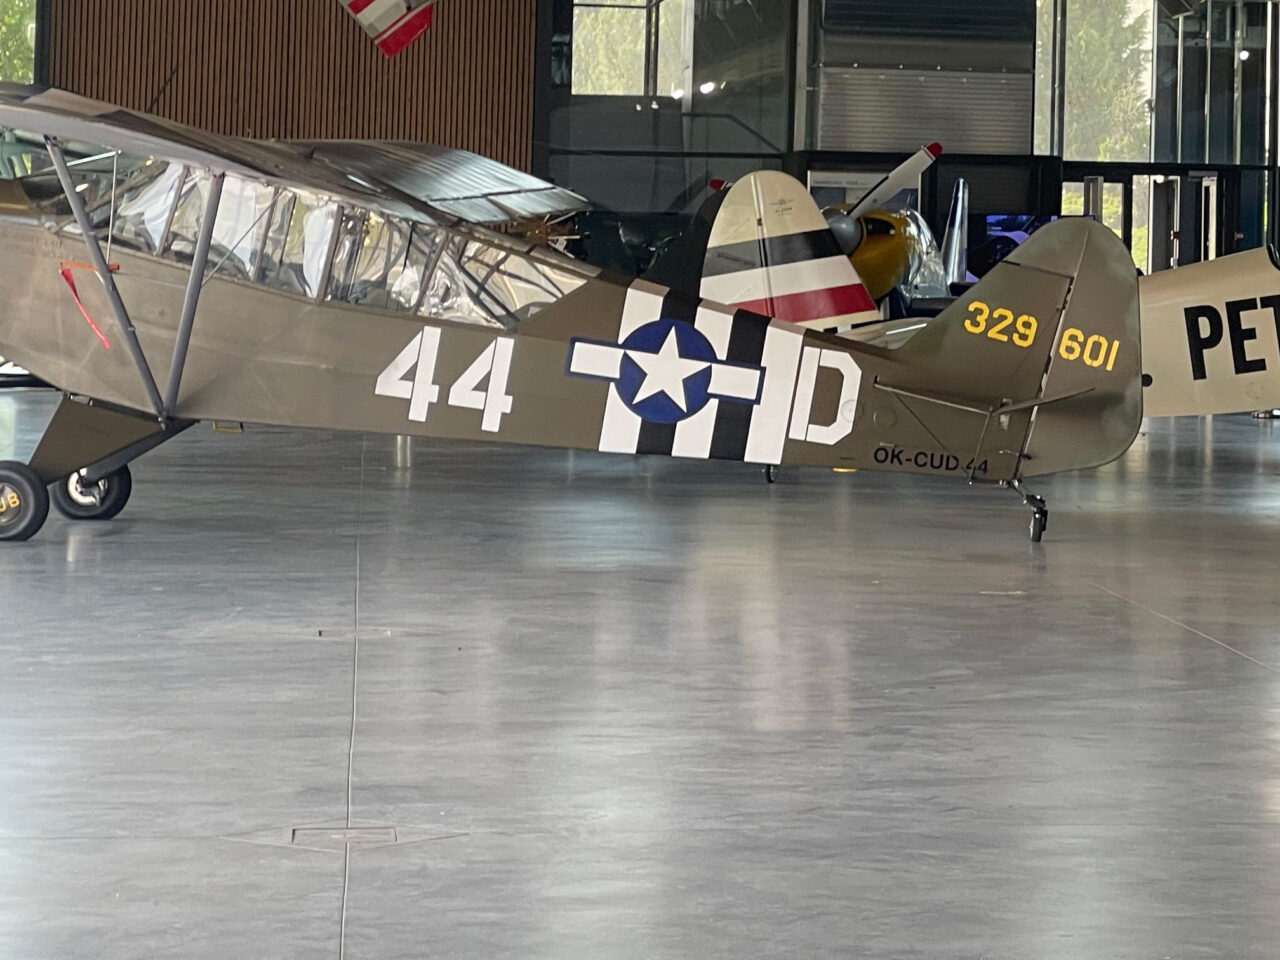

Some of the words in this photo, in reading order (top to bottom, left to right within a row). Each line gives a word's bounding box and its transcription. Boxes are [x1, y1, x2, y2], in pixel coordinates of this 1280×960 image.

[375, 326, 514, 432] 44
[964, 301, 1038, 348] 329
[1059, 327, 1120, 372] 601
[788, 346, 862, 446] D
[873, 447, 959, 471] OK-CUD
